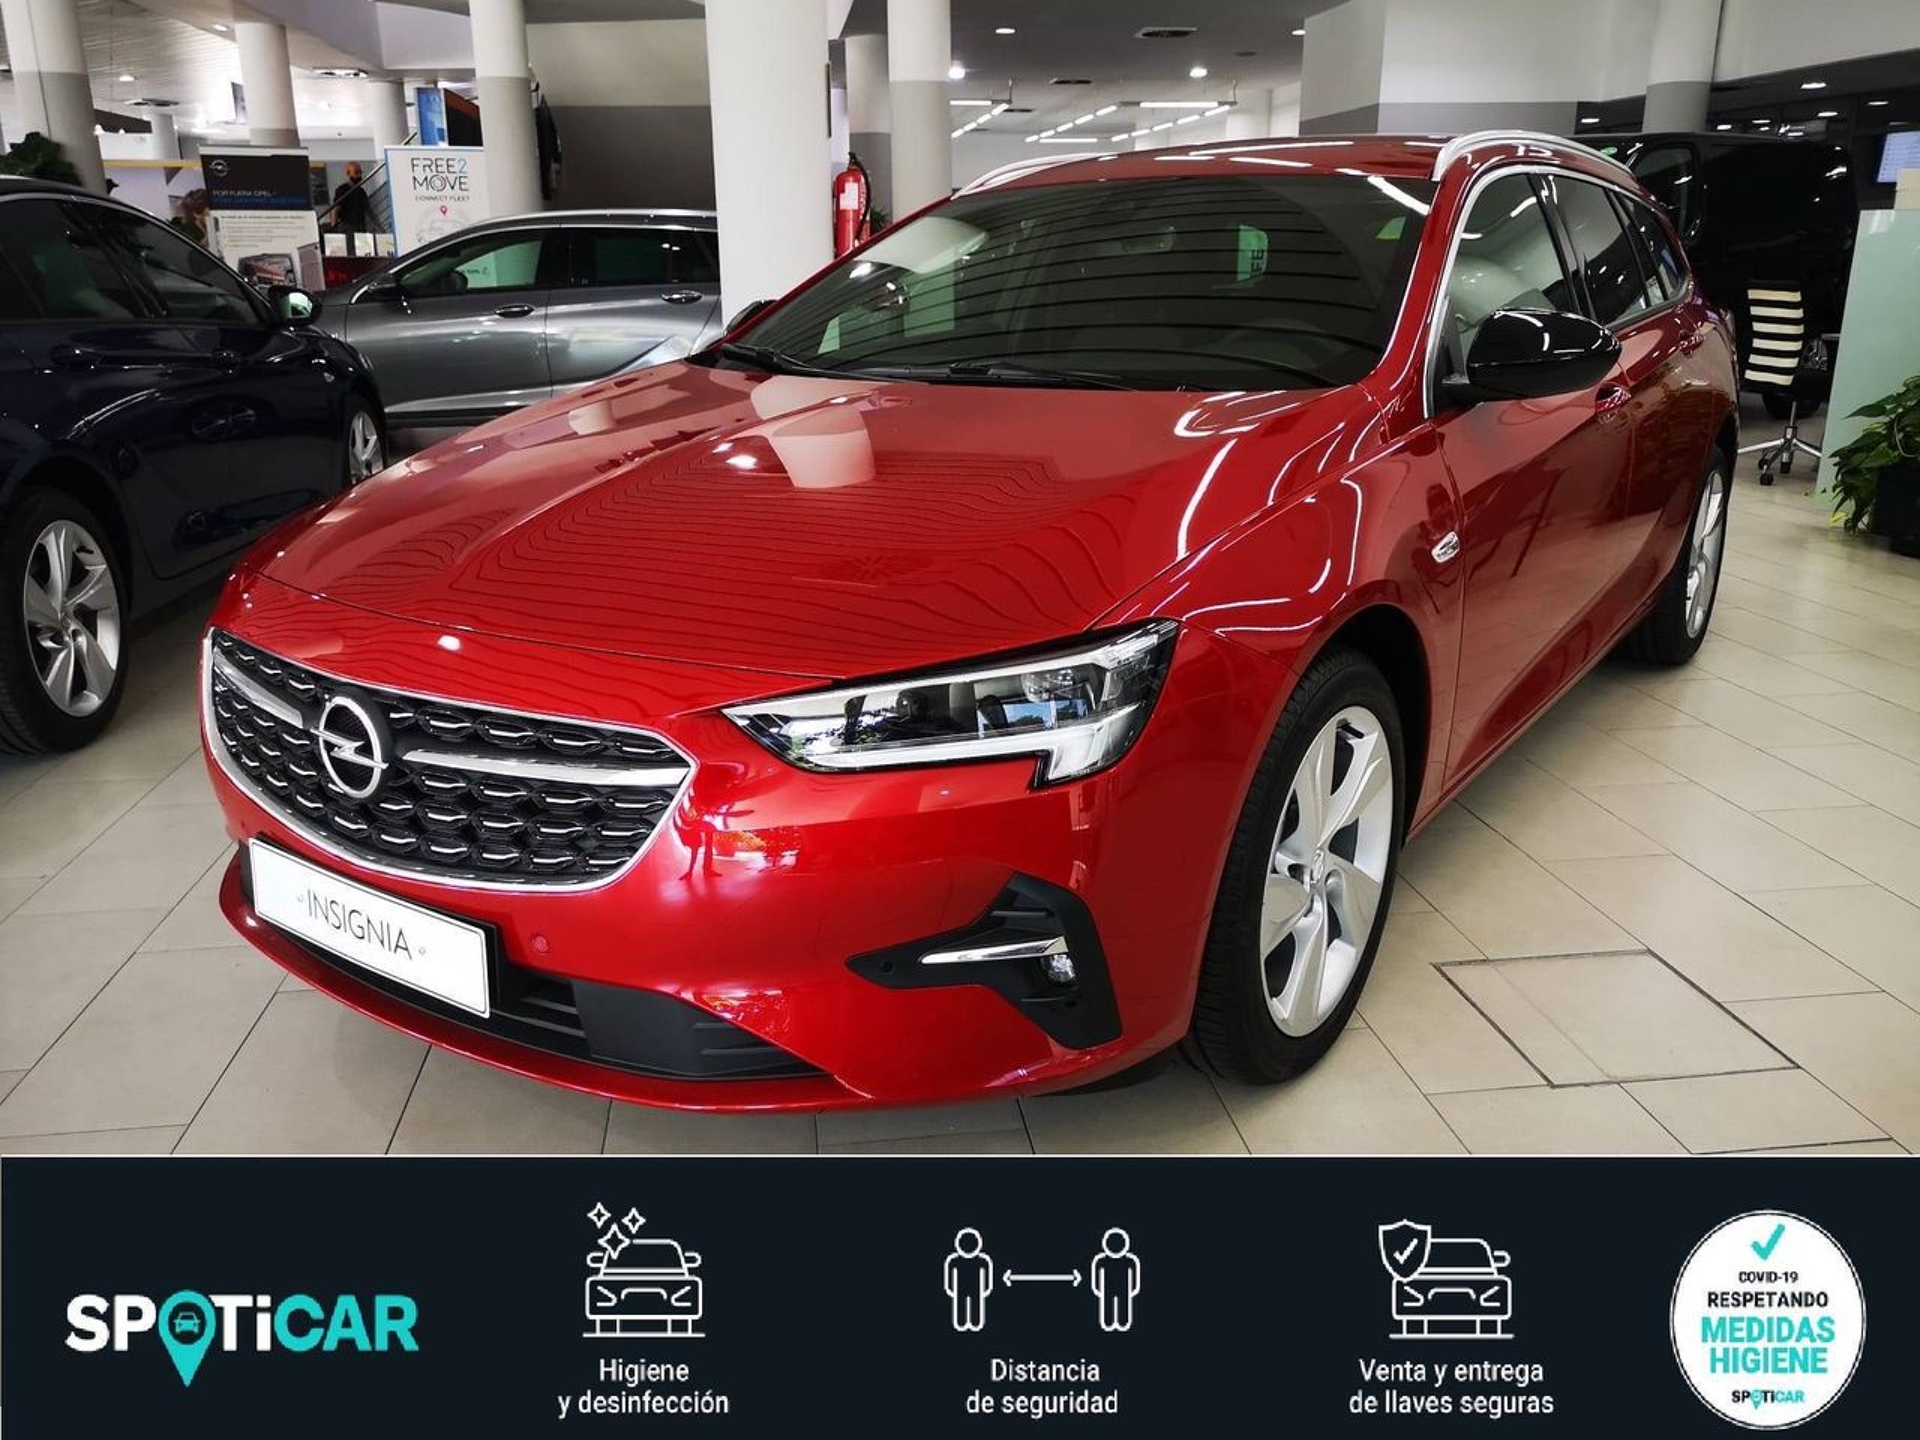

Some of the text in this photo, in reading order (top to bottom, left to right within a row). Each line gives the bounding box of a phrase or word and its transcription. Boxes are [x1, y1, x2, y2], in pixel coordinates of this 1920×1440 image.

[410, 157, 467, 174] FREE2
[412, 174, 469, 192] MOVE
[307, 888, 412, 960] INSIGNIA
